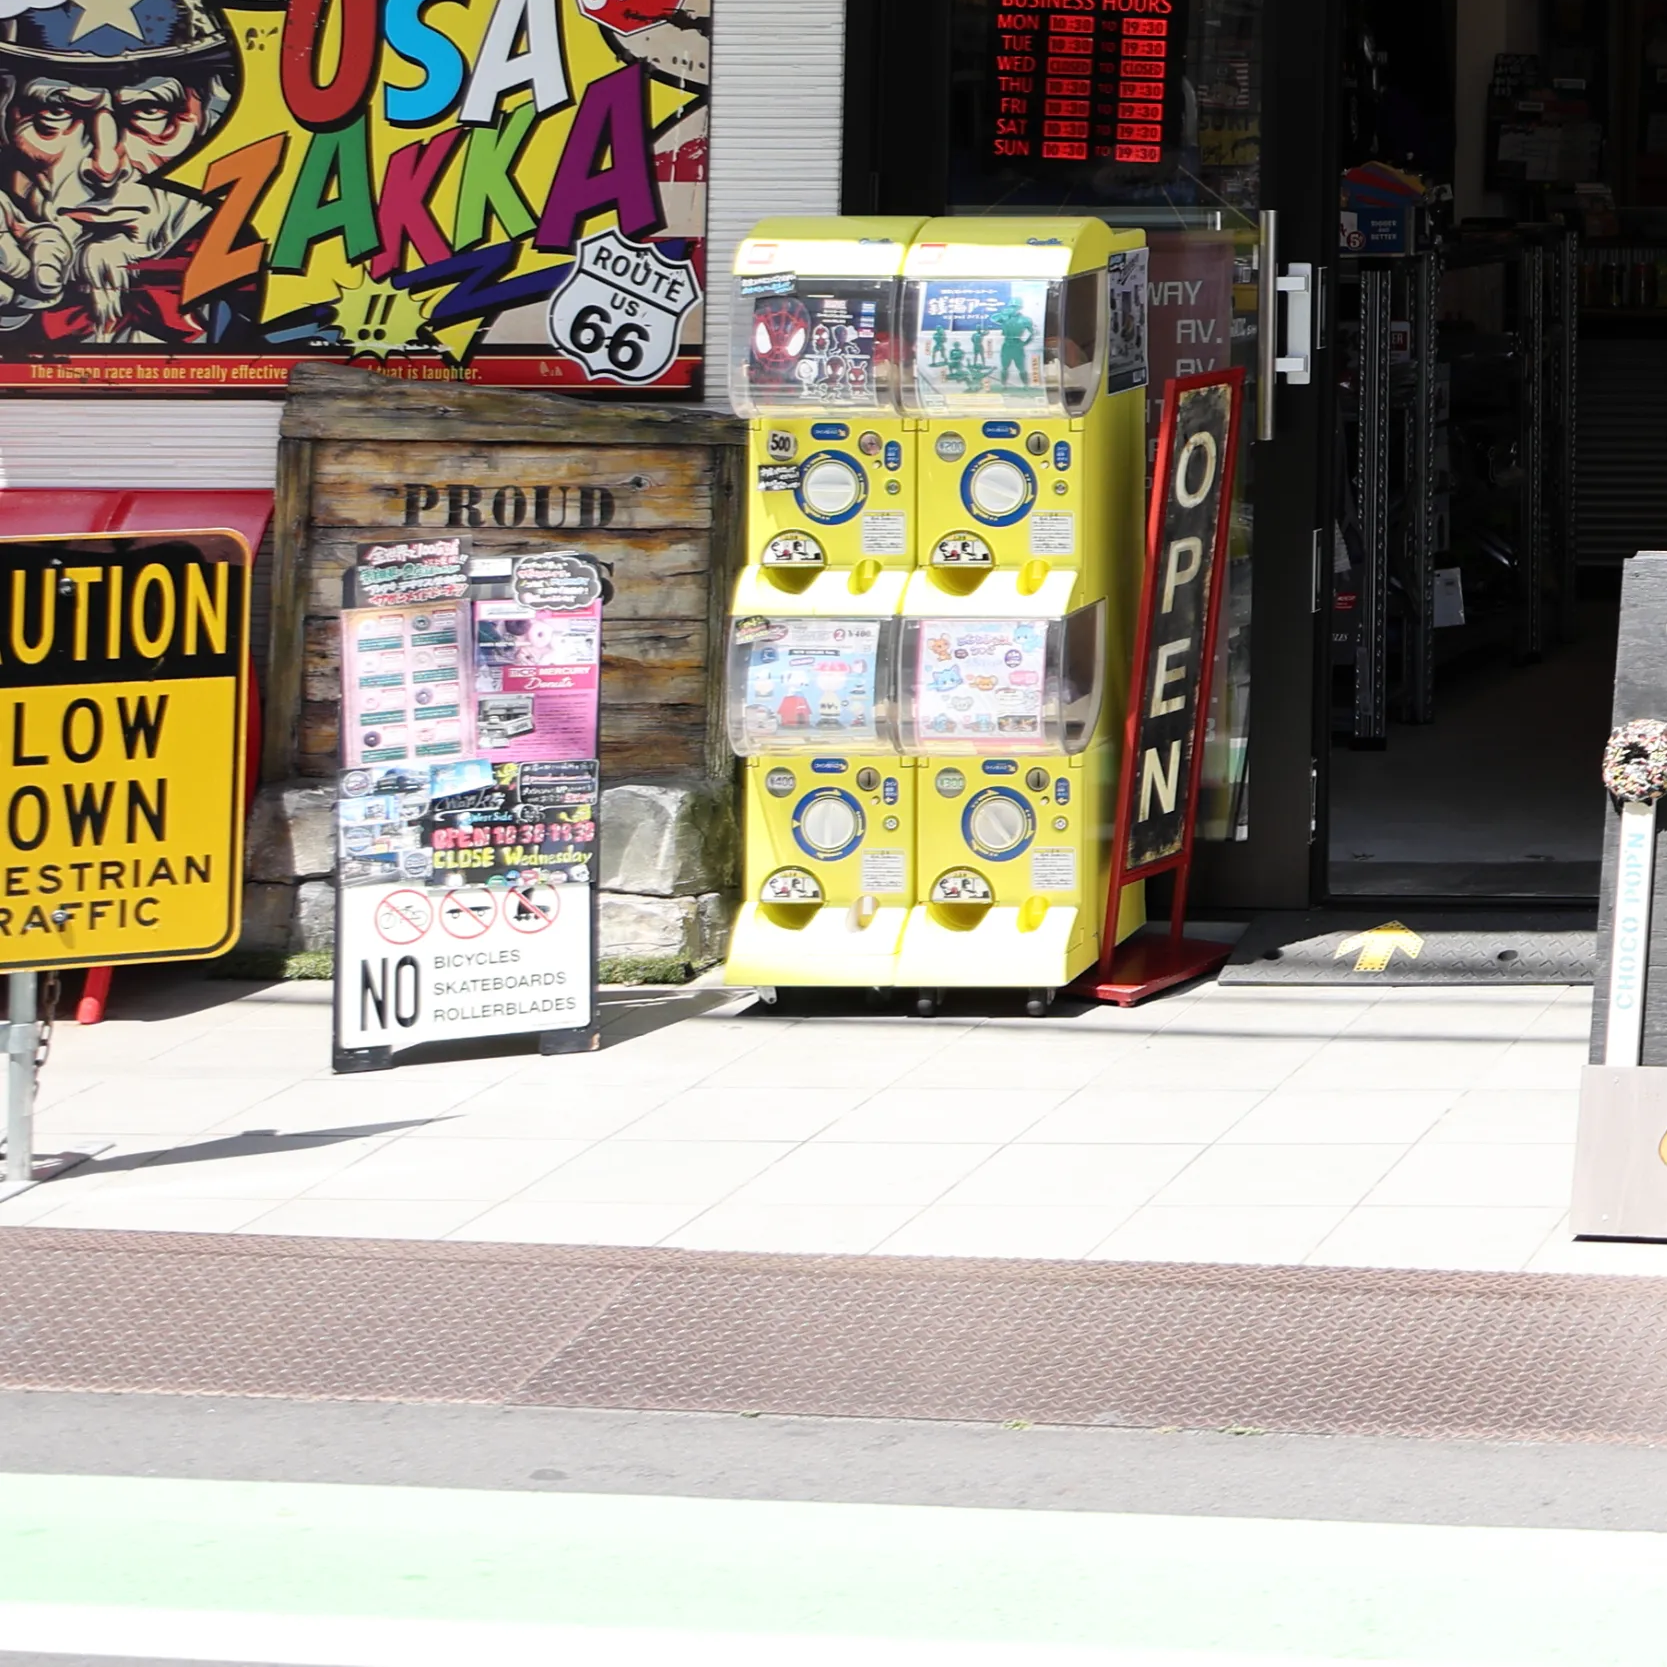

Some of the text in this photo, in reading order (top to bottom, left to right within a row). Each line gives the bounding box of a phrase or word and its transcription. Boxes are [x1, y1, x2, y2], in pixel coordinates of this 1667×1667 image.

[996, 14, 1040, 30] MON
[1125, 20, 1165, 34] 19:30
[1001, 35, 1033, 51] TUE
[1123, 41, 1164, 55] 19:30
[996, 56, 1036, 72] WED
[1122, 62, 1163, 76] CLOSED
[997, 77, 1033, 93] THU
[1121, 83, 1161, 97] 19:30
[1001, 98, 1027, 114] FRI
[1120, 104, 1160, 119] 19:30
[996, 118, 1027, 135] SAT
[1119, 125, 1159, 140] 19:30
[994, 139, 1030, 156] SUN
[1118, 147, 1157, 161] 19:30
[180, 66, 663, 313] ZAKKA
[592, 245, 684, 304] ROUTE
[609, 291, 640, 317] US
[570, 304, 651, 373] 66
[1176, 319, 1223, 344] AV.
[30, 364, 52, 379] The
[104, 364, 133, 379] race
[136, 364, 159, 379] has
[163, 365, 183, 379] one
[189, 364, 227, 383] really
[231, 364, 288, 380] effective
[407, 364, 419, 379] is
[422, 364, 483, 384] laughter.
[770, 433, 792, 453] 500
[404, 483, 617, 530] PROUD
[0, 561, 229, 665] UTION
[1138, 430, 1218, 823] OPEN
[12, 693, 169, 767] LOW
[8, 777, 168, 852] OWN
[432, 827, 491, 849] OPEN
[433, 844, 593, 869] CLOSE Wednesday
[434, 949, 520, 970] BICYCLES
[1615, 917, 1640, 1010] CHOCO
[360, 954, 421, 1031] NO
[433, 971, 567, 996] SKATEBOARDS
[433, 996, 576, 1023] ROLLERBLADES
